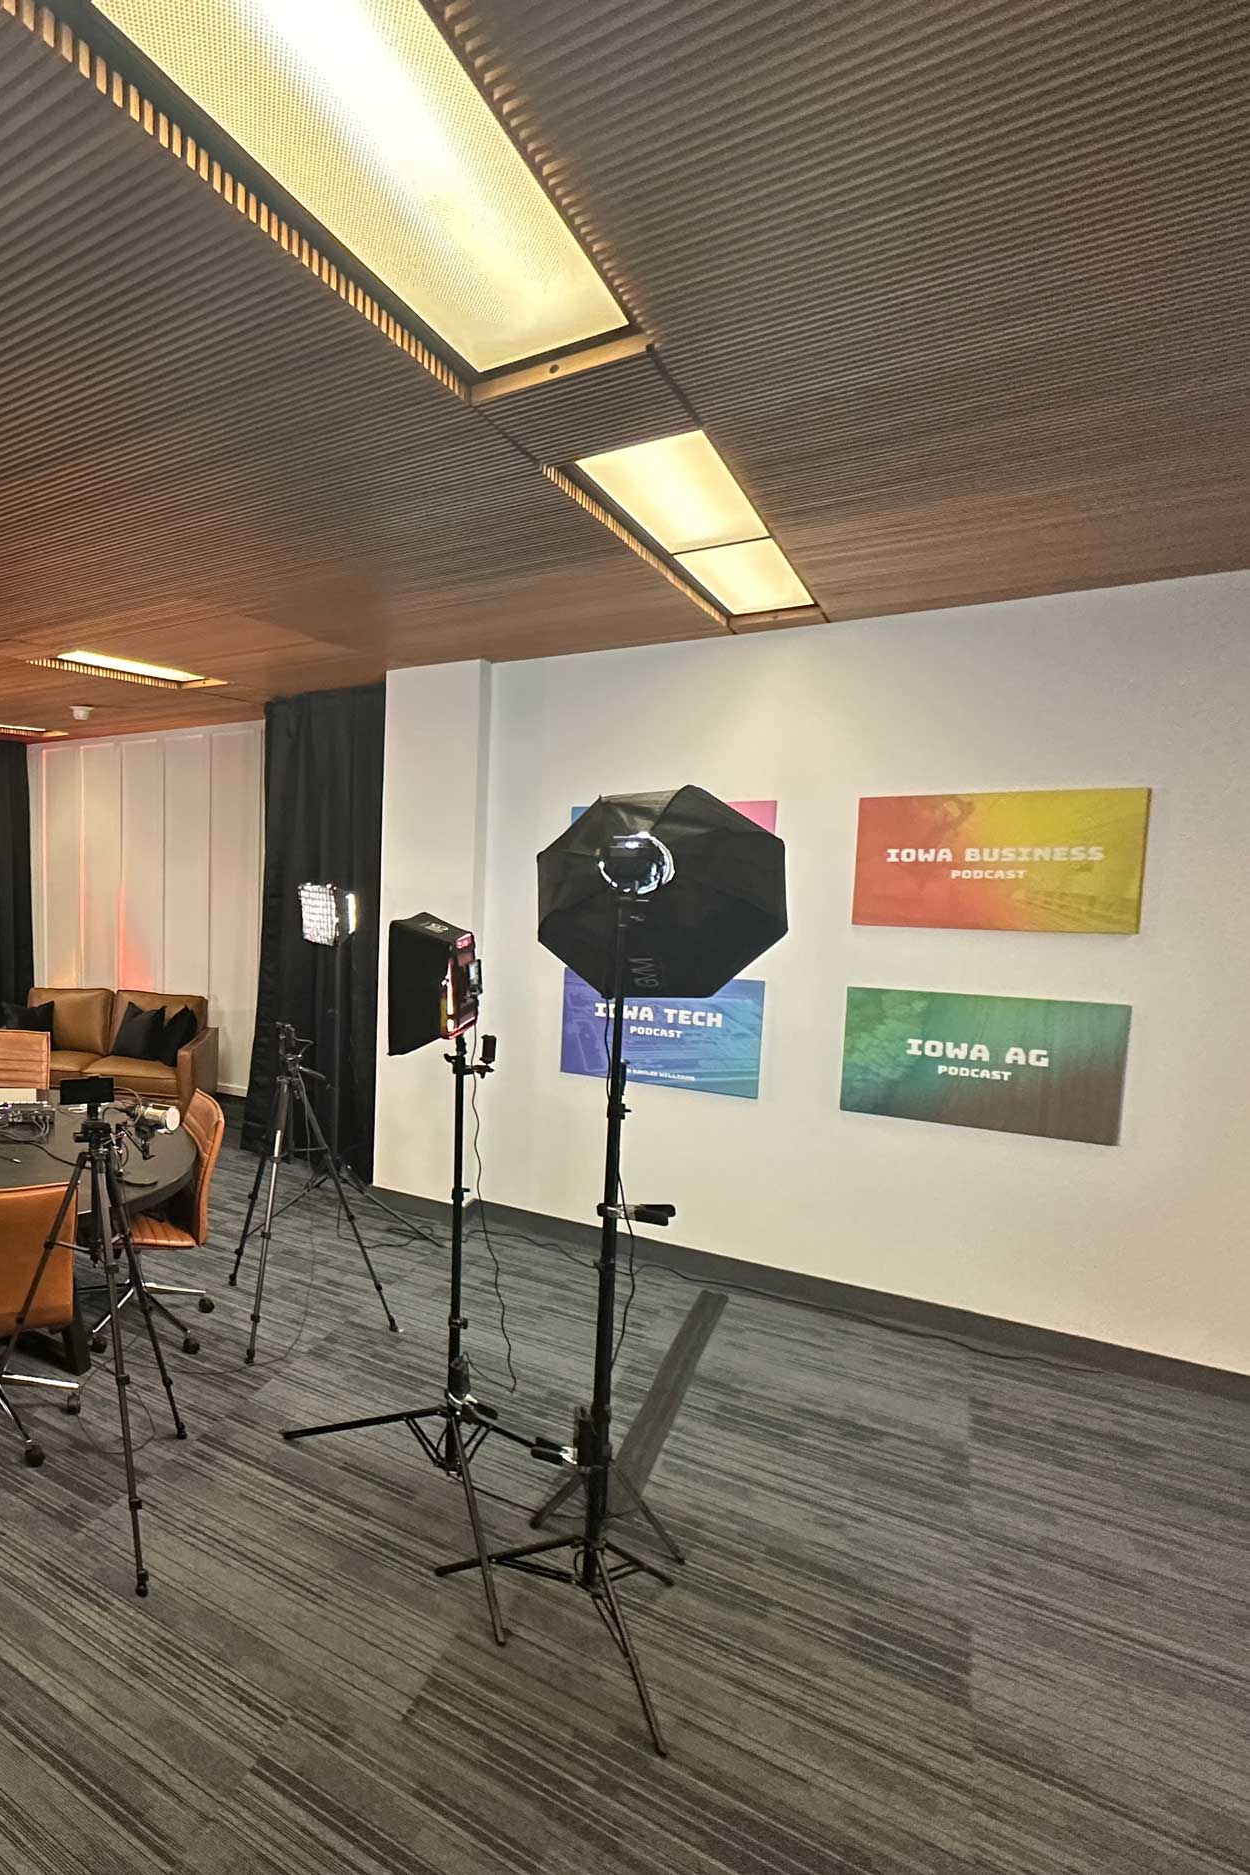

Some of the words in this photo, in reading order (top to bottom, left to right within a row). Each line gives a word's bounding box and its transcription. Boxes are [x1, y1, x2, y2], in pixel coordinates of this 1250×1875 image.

[886, 847, 953, 863] IOWA
[964, 846, 1104, 862] BUSINESS
[950, 869, 1026, 880] PODCAST
[663, 1008, 723, 1028] TECH
[630, 1025, 683, 1039] PODCAST
[906, 1038, 990, 1062] IOWA
[1004, 1047, 1050, 1068] AG
[937, 1064, 1012, 1081] PODCAST
